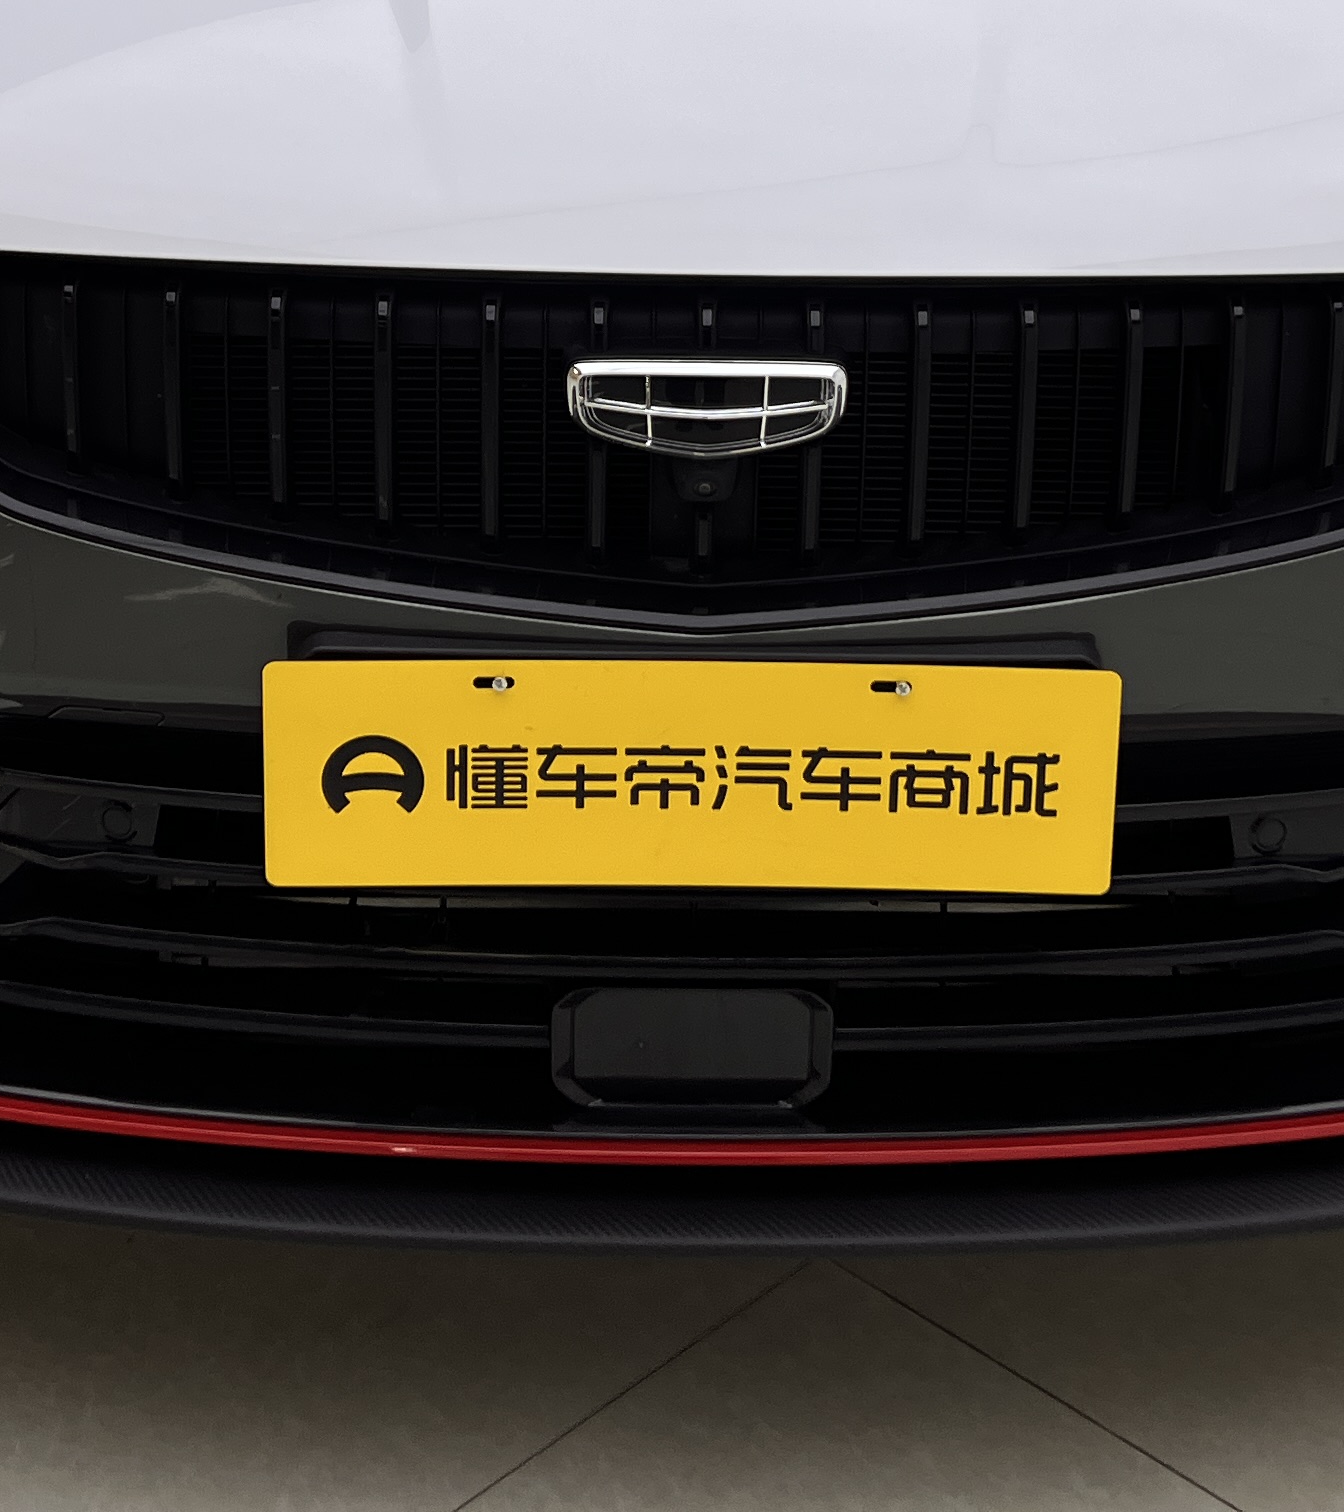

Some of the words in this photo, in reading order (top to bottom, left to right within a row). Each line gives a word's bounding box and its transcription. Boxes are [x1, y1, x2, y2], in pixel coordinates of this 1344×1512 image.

[445, 743, 1061, 818] 懂车帝汽车商城
